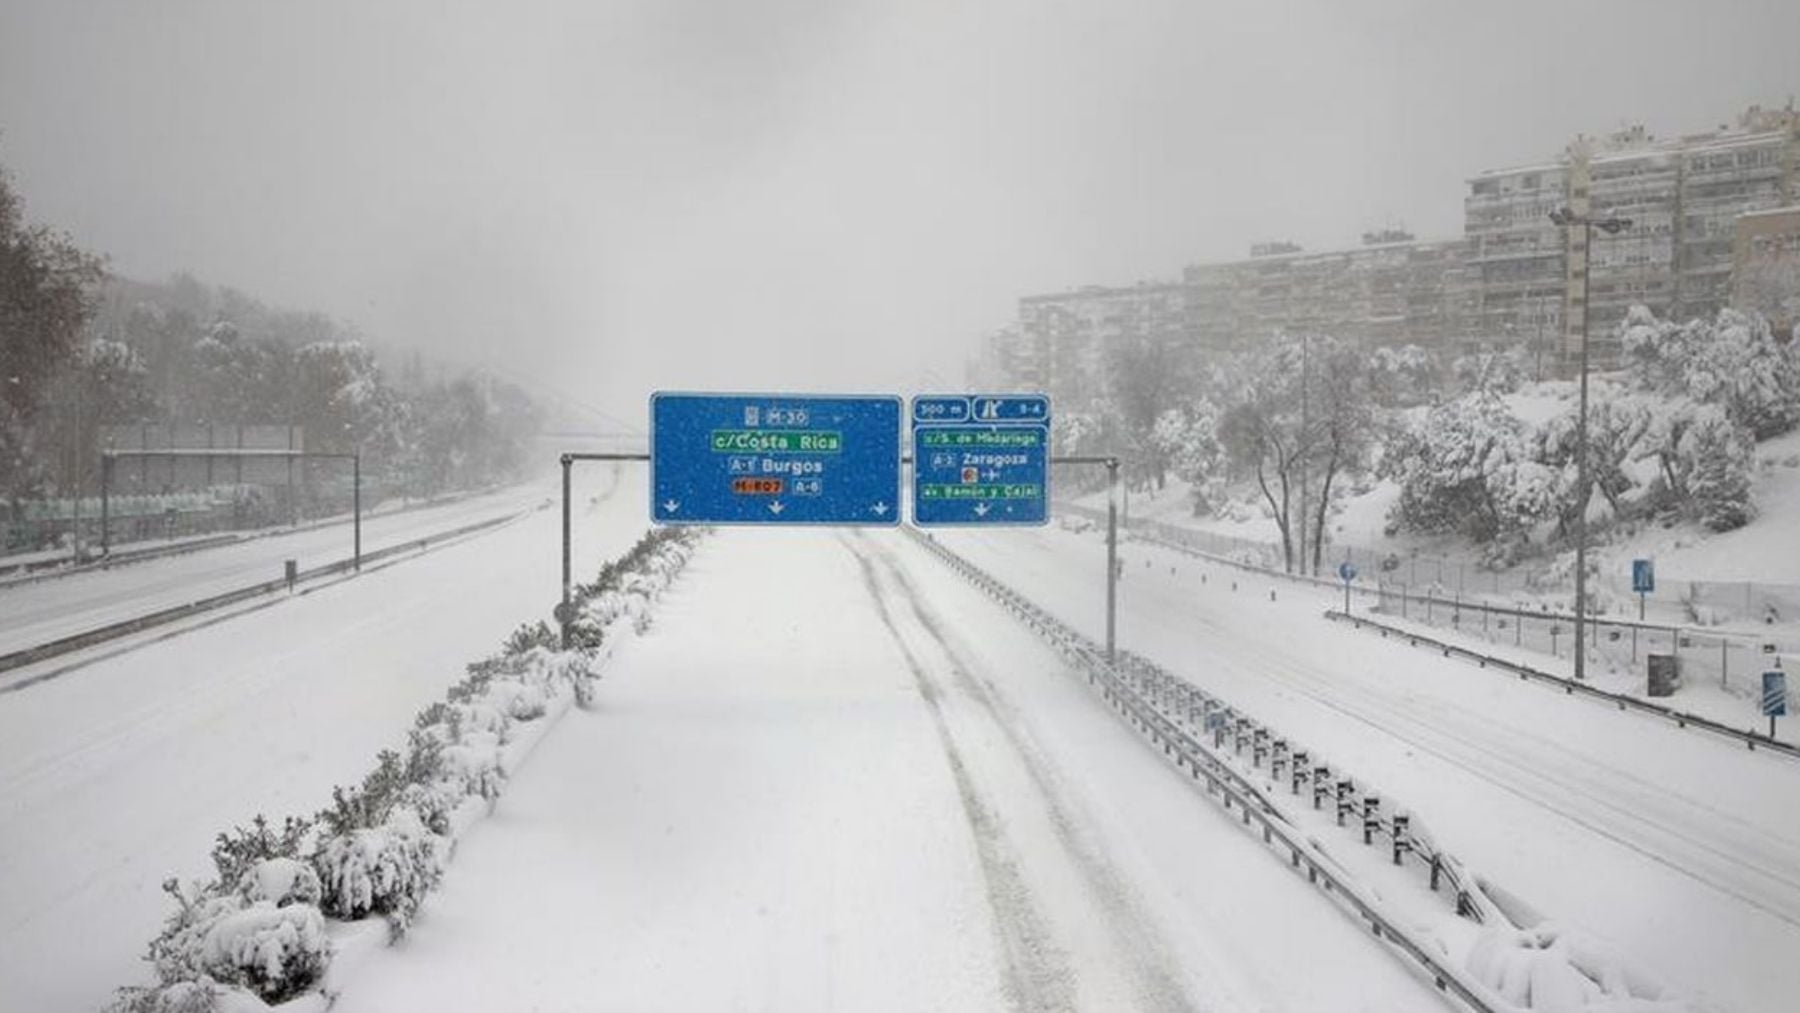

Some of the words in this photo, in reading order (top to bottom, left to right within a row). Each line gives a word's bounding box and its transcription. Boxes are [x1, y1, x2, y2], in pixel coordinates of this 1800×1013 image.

[715, 433, 788, 450] c/Costa
[800, 434, 838, 449] Rica
[956, 433, 972, 443] de
[762, 458, 823, 475] Burgos
[962, 453, 1028, 468] Zaragoza
